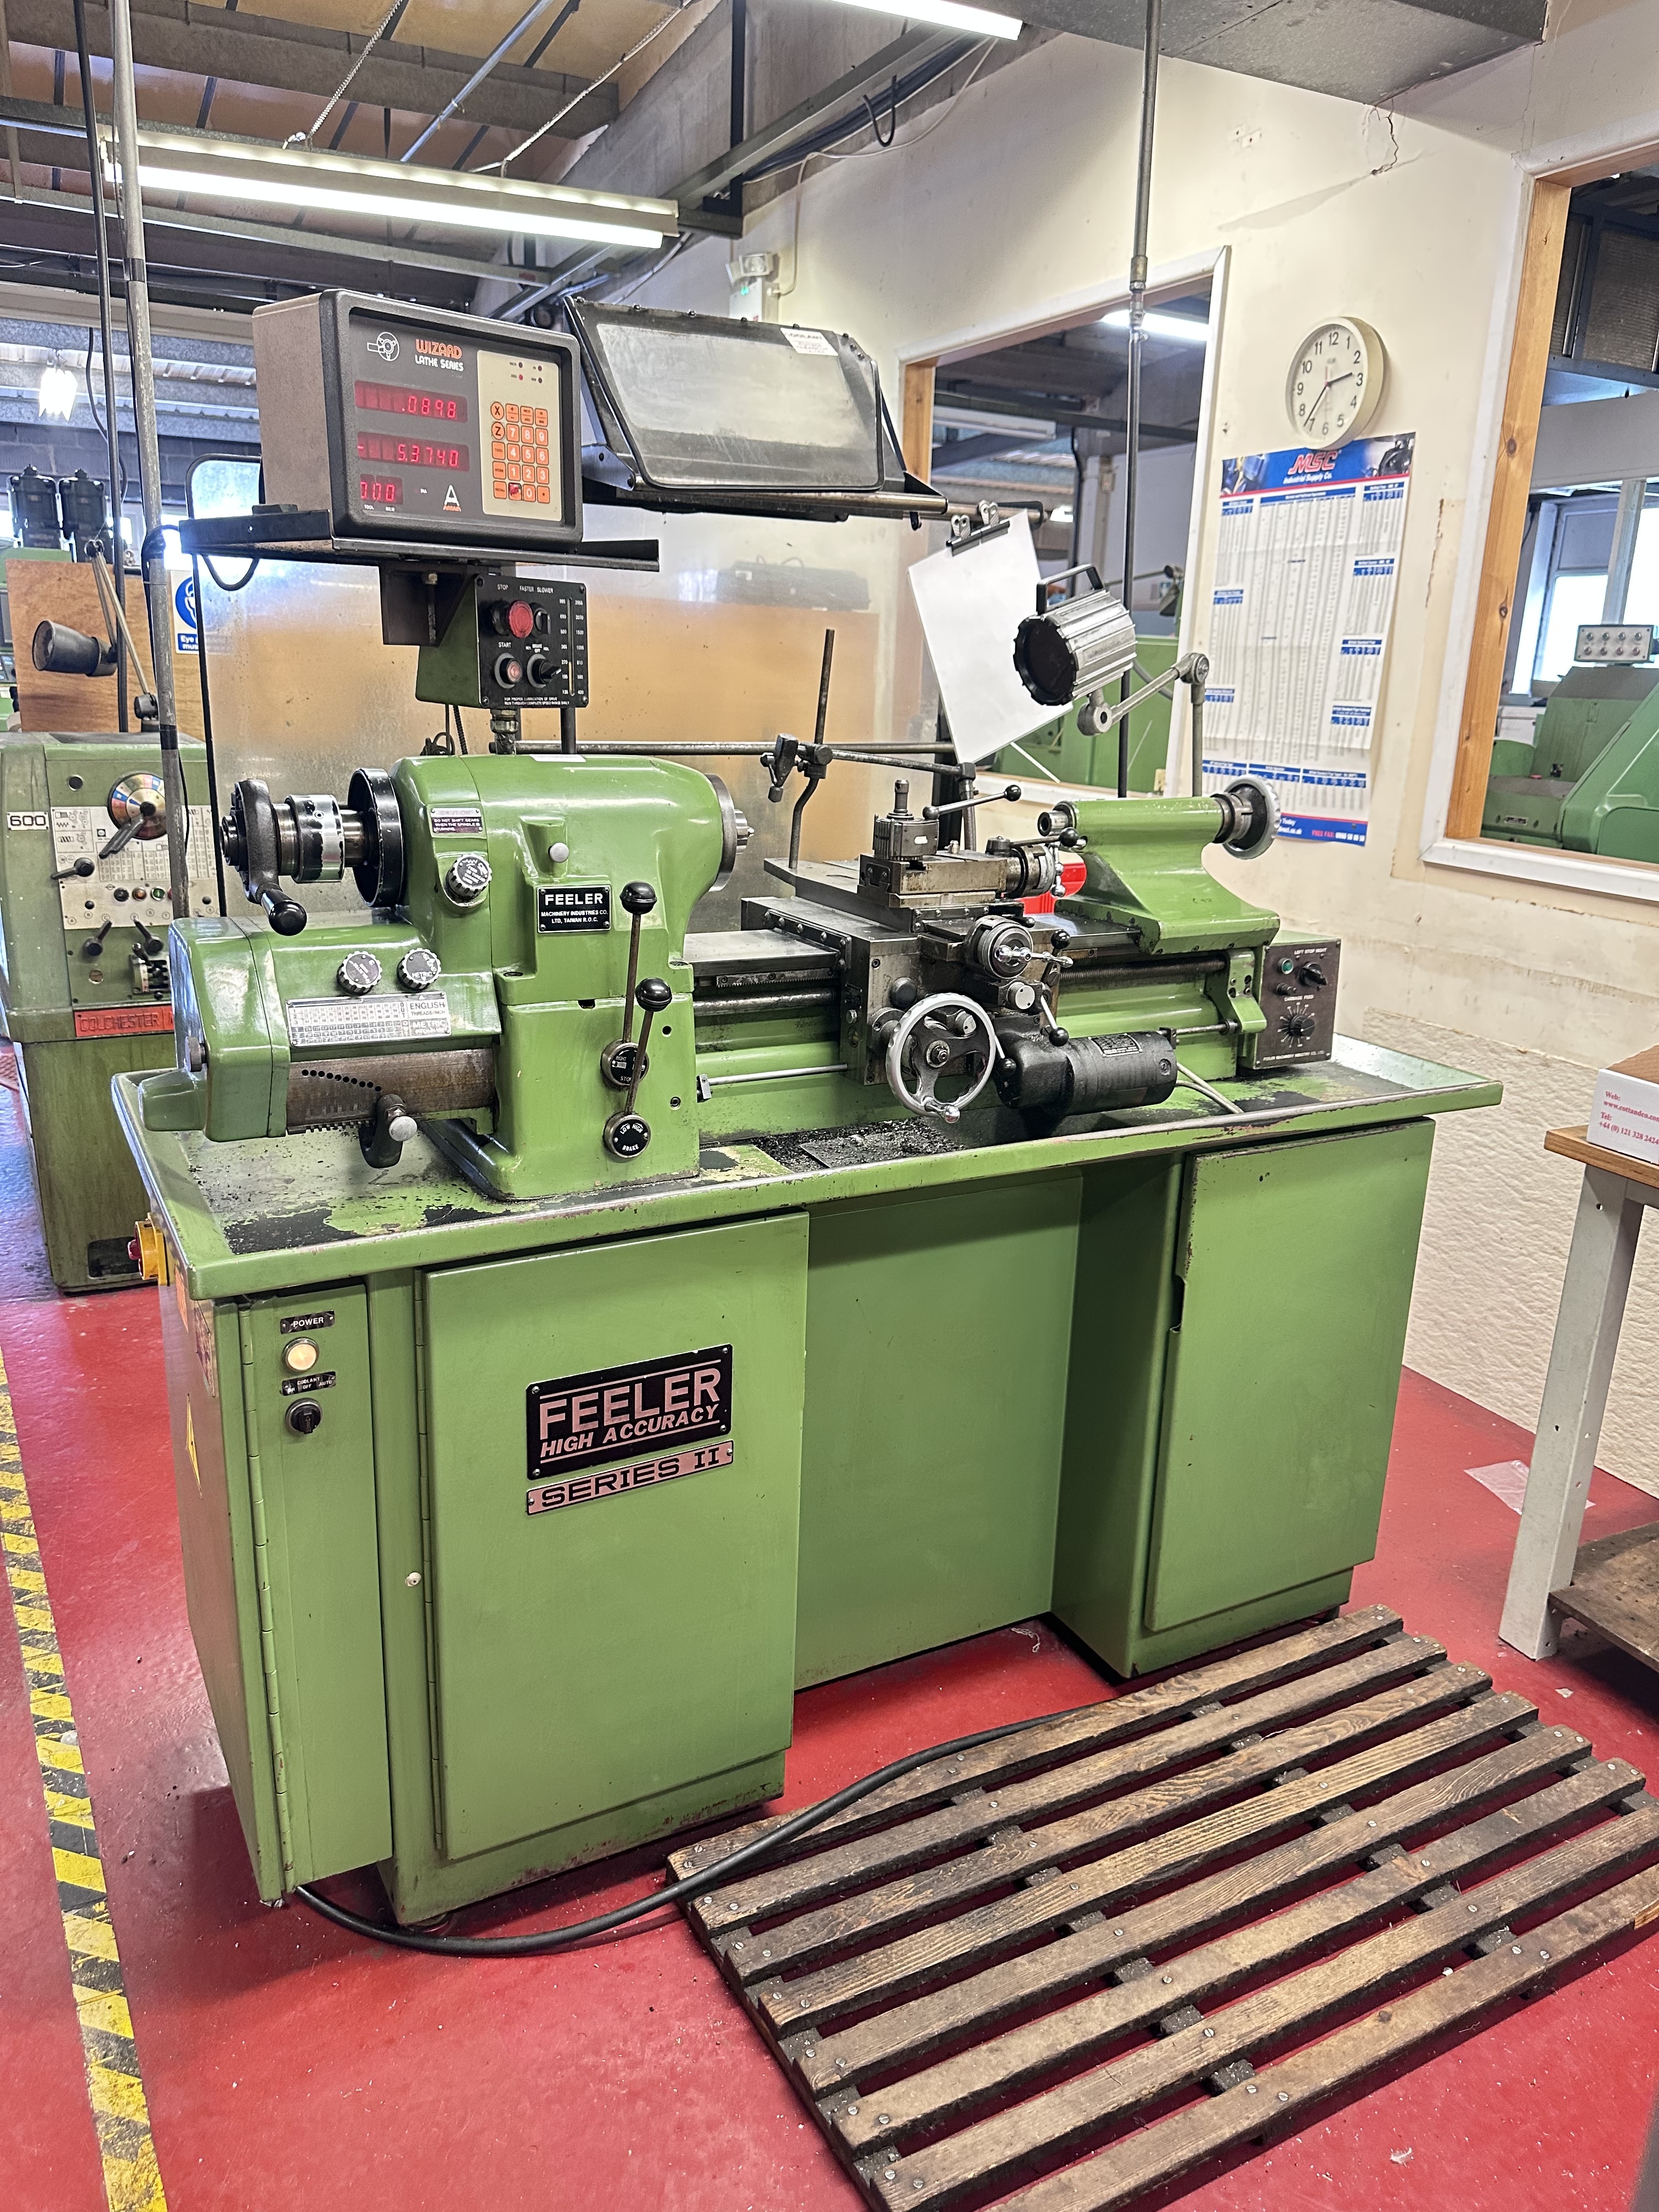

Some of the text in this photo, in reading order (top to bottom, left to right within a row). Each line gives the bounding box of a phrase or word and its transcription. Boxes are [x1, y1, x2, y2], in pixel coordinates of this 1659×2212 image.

[1329, 331, 1339, 346] 12
[1346, 336, 1350, 349] 1
[416, 338, 462, 359] WIZARD
[1315, 341, 1323, 355] 11
[415, 355, 464, 371] LATHE SERIES
[1353, 350, 1361, 364] 2
[1302, 360, 1312, 374] 10
[1356, 373, 1363, 386] 3
[1297, 382, 1304, 396] 9
[1350, 395, 1357, 408] 4
[495, 406, 500, 416] X
[1299, 404, 1306, 417] 8
[1309, 417, 1316, 431] 7
[1337, 414, 1344, 428] 5
[495, 426, 501, 436] Z
[510, 428, 516, 438] 7
[524, 430, 531, 439] 8
[1322, 422, 1329, 436] 6
[539, 432, 545, 442] 9
[397, 443, 459, 467] 5.3740
[510, 447, 516, 457] 4
[525, 450, 531, 459] 5
[539, 450, 546, 461] 6
[1288, 450, 1338, 475] MSC
[511, 467, 516, 477] 1
[526, 469, 532, 479] 2
[540, 470, 546, 481] 3
[1283, 474, 1306, 484] Industrial
[1306, 473, 1324, 483] Supply
[526, 488, 532, 498] 0
[180, 635, 195, 644] Eye
[10, 815, 47, 826] 600
[545, 893, 603, 906] FEELER
[410, 1001, 445, 1010] ENGLISH
[80, 1012, 160, 1032] COLCHESTER
[413, 1019, 447, 1029] METRIC
[1605, 1091, 1621, 1101] Web:
[1600, 1111, 1612, 1121] Tel:
[620, 1124, 644, 1135] LOW HIGH
[1599, 1121, 1610, 1130] +44
[1611, 1125, 1620, 1133] (0)
[1621, 1127, 1631, 1136] 121
[1632, 1131, 1644, 1140] 328
[293, 1317, 324, 1328] POWER
[297, 1376, 320, 1385] COOLANT
[540, 1368, 721, 1440] FEELER
[540, 1403, 719, 1458] HIGH ACCURACY
[541, 1447, 720, 1508] SERIES II
